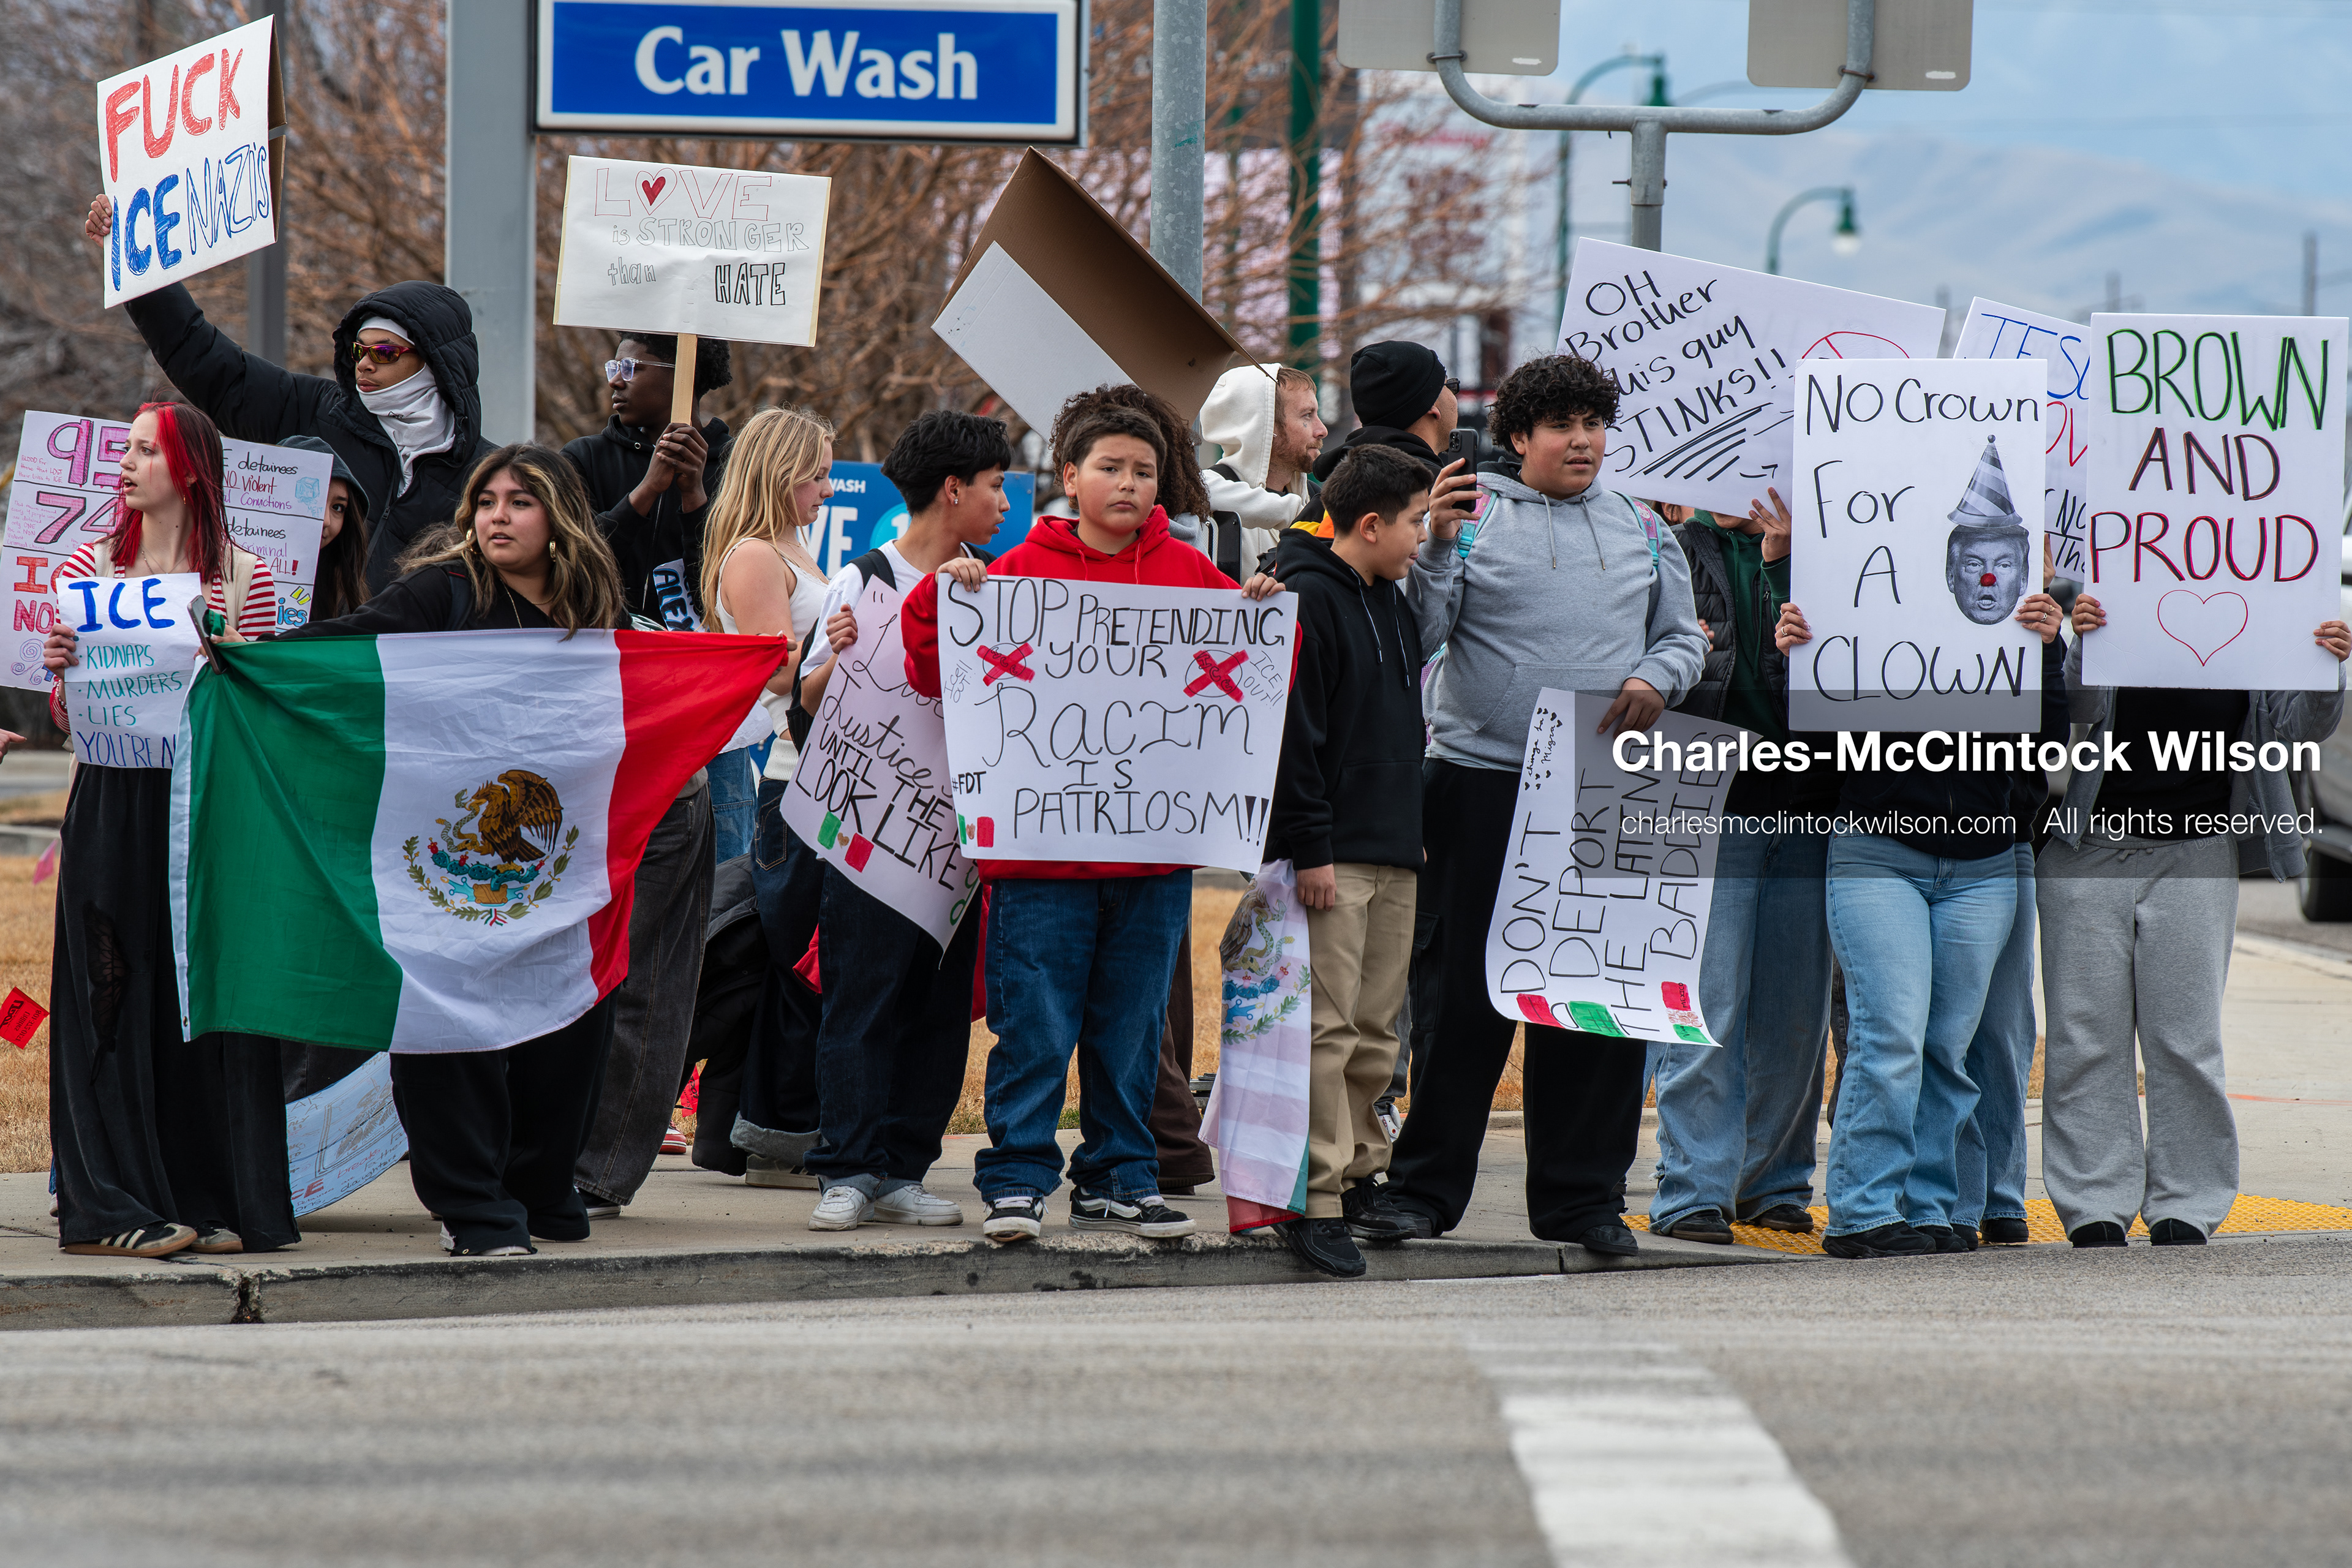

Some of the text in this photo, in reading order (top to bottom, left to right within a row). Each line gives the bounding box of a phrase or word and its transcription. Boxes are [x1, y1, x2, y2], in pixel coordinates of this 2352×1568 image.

[635, 26, 979, 100] Car Wash
[105, 48, 243, 183] FUCK
[595, 167, 772, 222] LOVE
[111, 174, 183, 292] ICE
[612, 217, 809, 253] is STRONGER
[608, 258, 786, 306] than HATE
[1585, 270, 1662, 316] OH
[1566, 279, 1717, 363] Brother
[1682, 315, 1756, 369] guy
[1806, 374, 2038, 435] NO Crown
[2106, 328, 2329, 431] BROWN
[238, 451, 298, 474] detainees
[2128, 427, 2280, 501] AND
[227, 516, 286, 540] detainees
[240, 492, 292, 510] Convictions
[1814, 460, 1915, 538] For
[1853, 545, 1901, 608] A
[2090, 511, 2319, 582] PROUD
[68, 578, 176, 633] ICE
[948, 578, 1284, 647] STOP PRETENDING
[86, 644, 154, 669] KIDNAPS
[86, 671, 183, 700] MURDERS
[1045, 641, 1167, 679] YOUR
[1813, 635, 2026, 701] CLOWN
[88, 705, 137, 727] LIES
[823, 663, 935, 790] Justice
[76, 731, 154, 767] YOU'RE
[819, 723, 876, 790] UNTIL
[1062, 760, 1134, 791] IS
[951, 771, 987, 794] #FDT
[796, 743, 959, 891] LOOK LIKE
[1501, 810, 1561, 994] DON'T
[1549, 767, 1615, 978] DEPORT
[1604, 939, 1660, 1035] THE
[1679, 981, 1689, 1009] MEXICO
